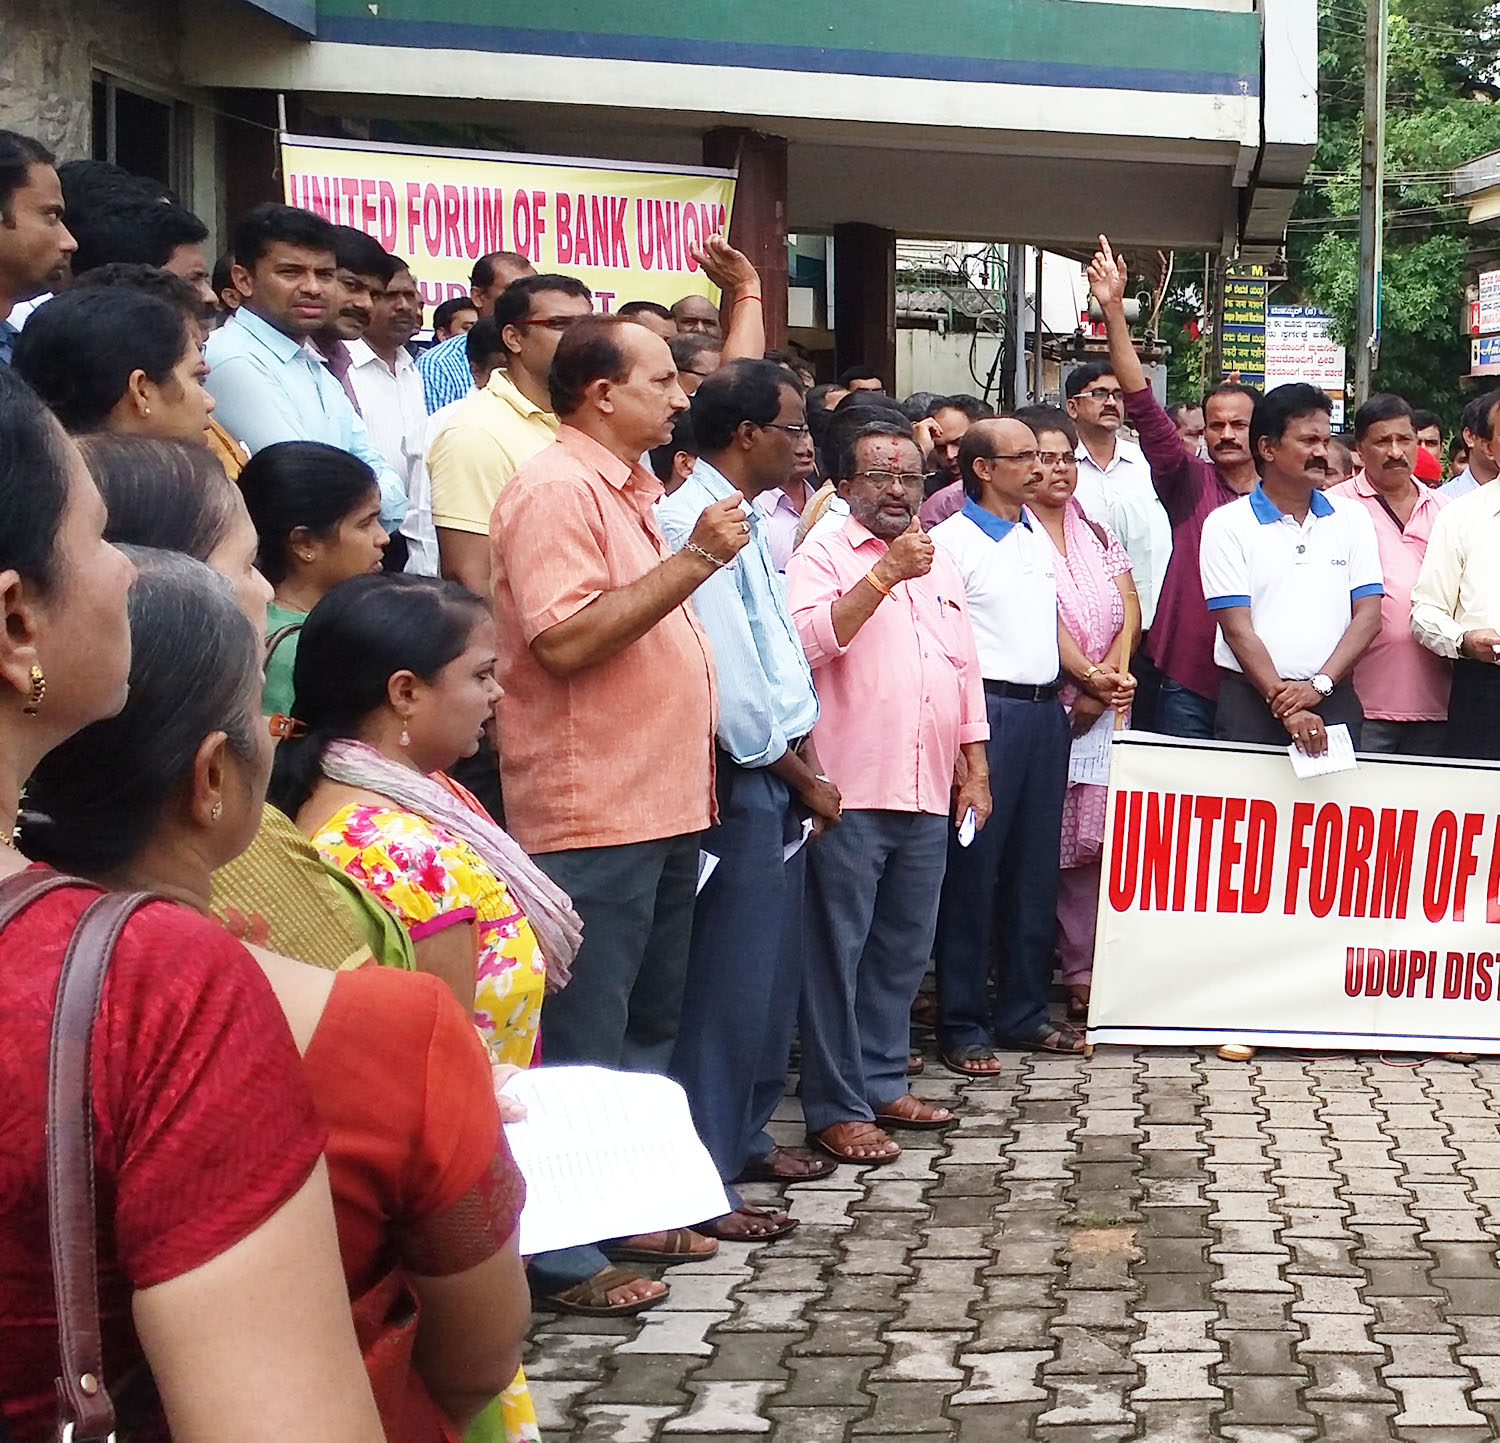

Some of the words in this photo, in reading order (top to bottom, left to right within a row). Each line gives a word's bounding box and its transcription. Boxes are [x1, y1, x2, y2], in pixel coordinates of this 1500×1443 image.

[406, 183, 503, 260] FORUM
[513, 188, 547, 263] OF
[556, 192, 630, 269] BANK
[1108, 790, 1278, 915] UNITED
[1283, 801, 1418, 920] FORM
[1423, 810, 1486, 924] OF
[1344, 946, 1438, 999] UDUPI
